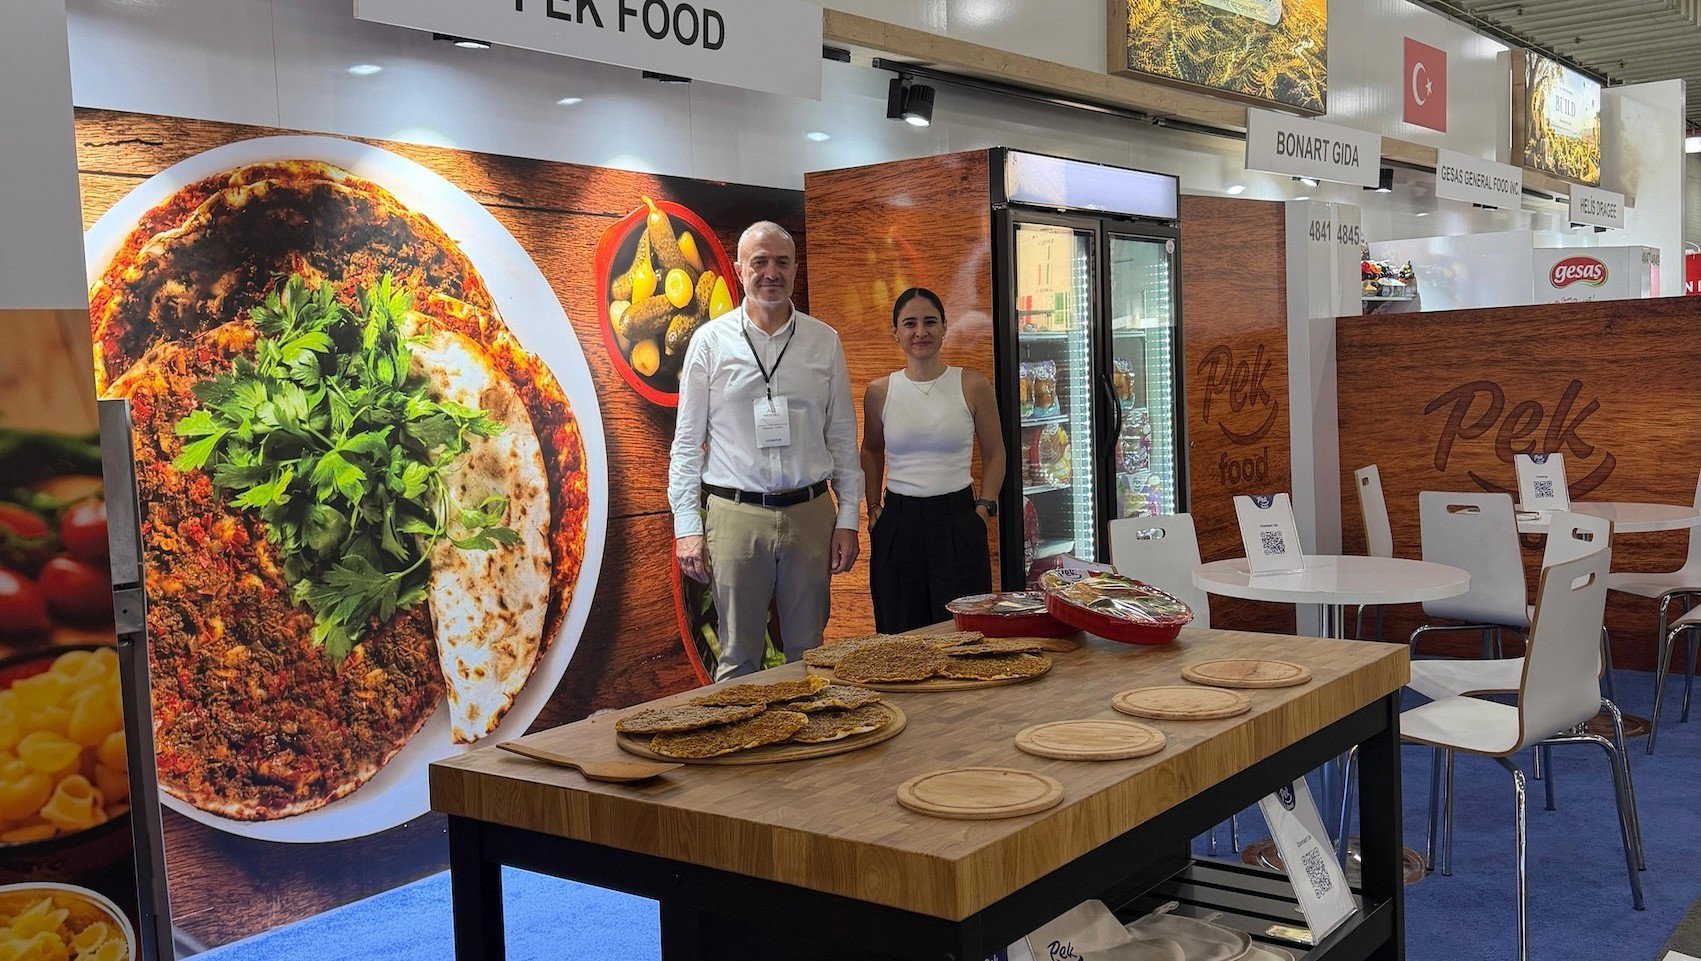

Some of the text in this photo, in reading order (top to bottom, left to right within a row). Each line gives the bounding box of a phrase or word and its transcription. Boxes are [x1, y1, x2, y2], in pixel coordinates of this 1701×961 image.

[515, 0, 725, 51] EK FOOD
[1276, 130, 1360, 168] BONART GIDA
[1441, 165, 1463, 184] GESAS
[1464, 170, 1493, 190] GENERAL
[1493, 176, 1509, 194] FOOD
[1309, 220, 1331, 242] 4841
[1337, 224, 1360, 245] 4845
[1197, 343, 1272, 424] Pek
[1424, 379, 1601, 473] Pek
[1219, 447, 1269, 486] food
[1047, 940, 1078, 961] Pek
